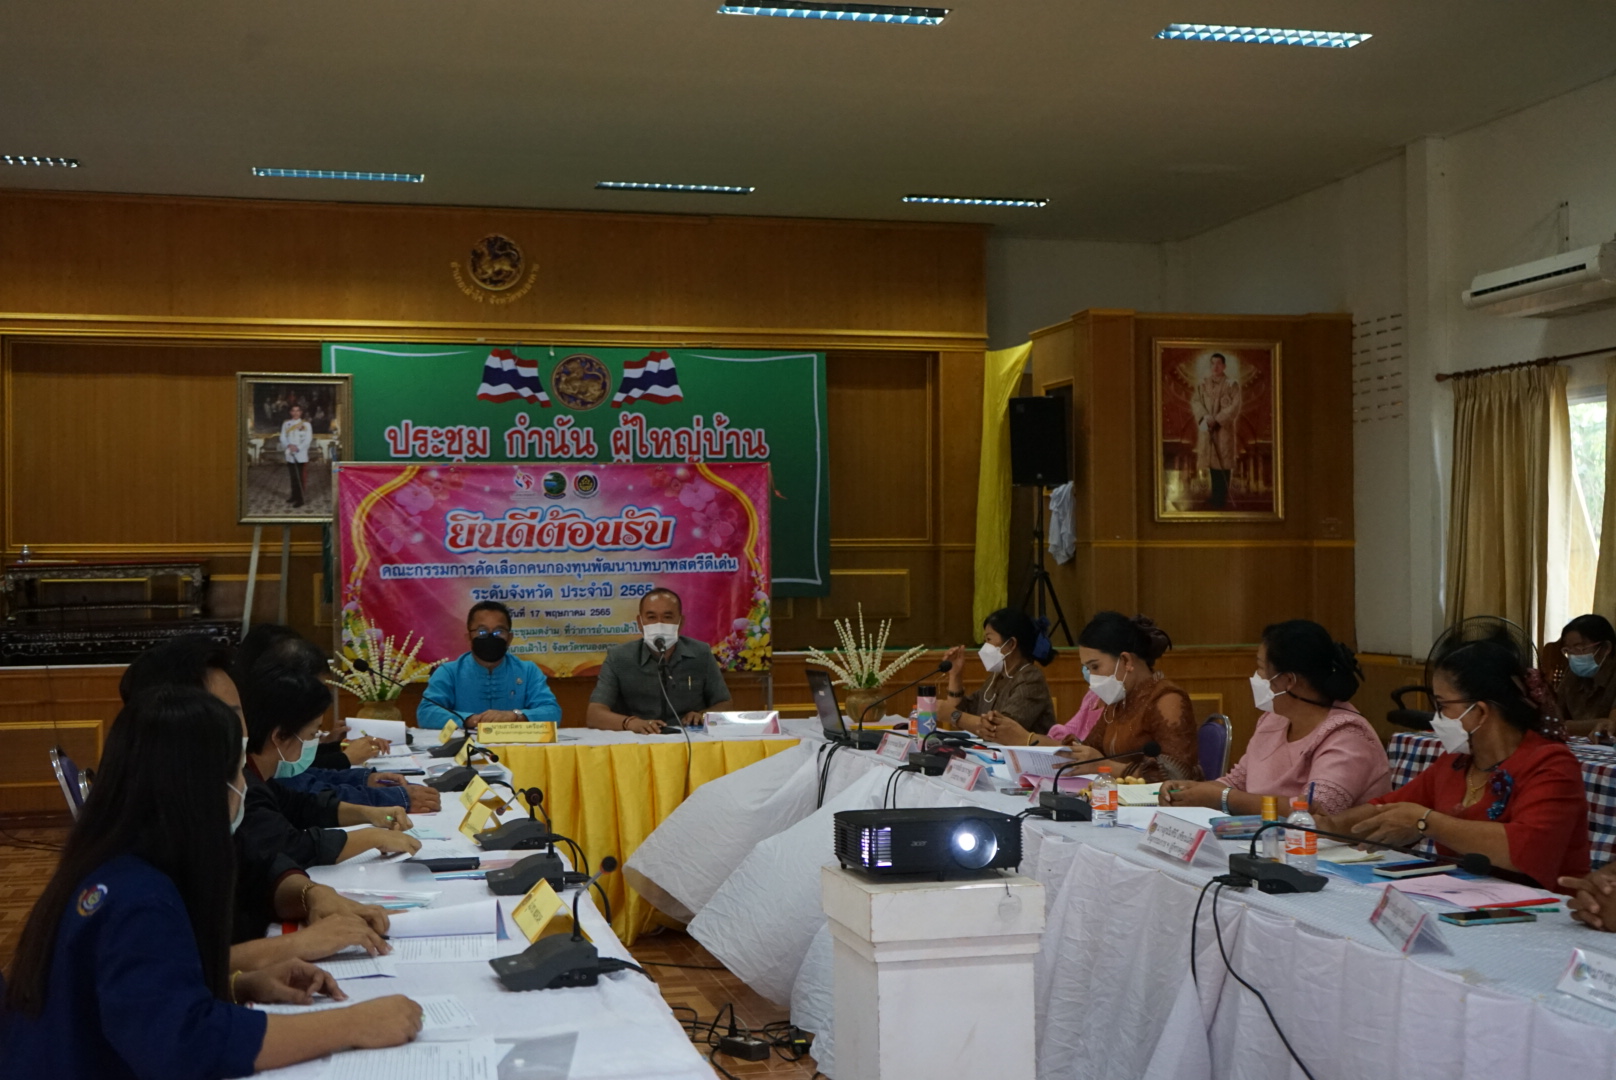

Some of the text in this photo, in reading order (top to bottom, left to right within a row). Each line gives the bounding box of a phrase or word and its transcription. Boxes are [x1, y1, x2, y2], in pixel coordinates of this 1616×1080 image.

[385, 411, 769, 463] ประชุม กำนัน ผู้ใหญ่บ้าน
[447, 507, 673, 550] ยินดีต้อนรับ
[381, 555, 738, 579] คณะกรรมการคัดเลือกคนกองทุนพัฒนาบทบาทสตรีดีเด่น
[472, 581, 653, 600] ระดับจังหวัด ประจำปี 2565
[530, 609, 540, 618] 17
[545, 608, 586, 619] พฤษภาคม
[590, 608, 611, 616] 2565
[564, 622, 639, 635] ที่ว่าการอำเภอเฝ้าไ
